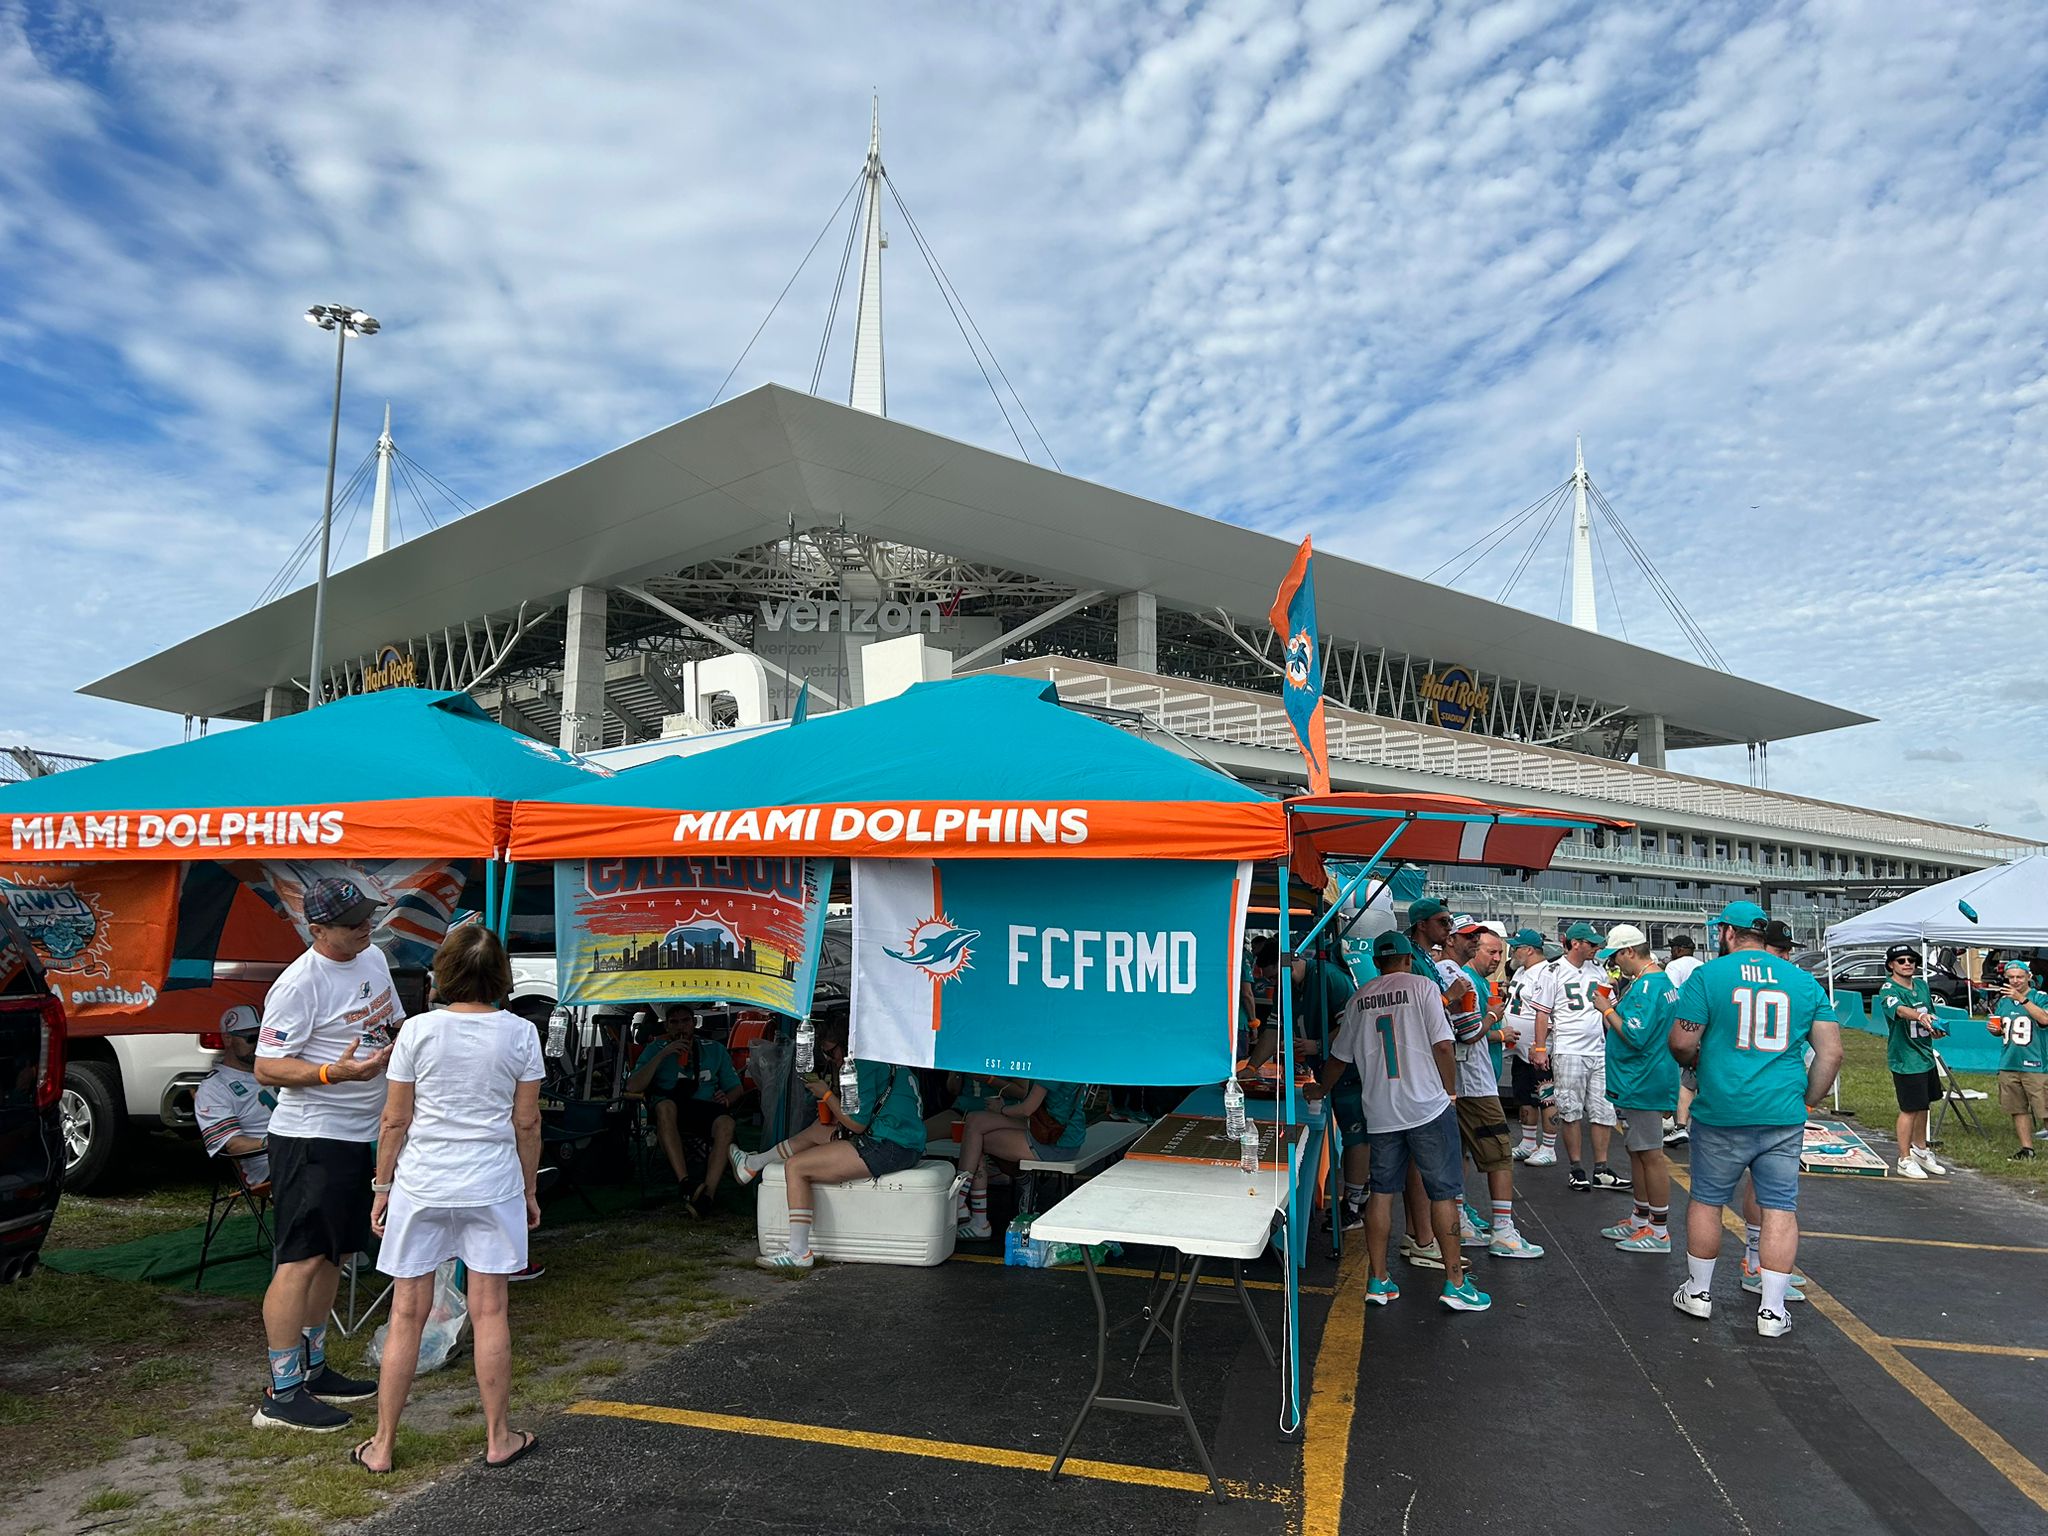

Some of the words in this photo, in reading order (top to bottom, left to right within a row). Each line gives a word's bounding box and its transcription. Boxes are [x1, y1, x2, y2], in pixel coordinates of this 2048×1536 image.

[759, 599, 941, 633] verizon
[759, 641, 818, 655] verizon
[364, 661, 388, 693] Hard
[389, 654, 416, 685] Rock
[801, 663, 849, 678] verizo
[1420, 673, 1459, 703] Hard
[1455, 681, 1489, 715] Rock
[1440, 711, 1466, 724] STADIUM
[11, 815, 128, 850] MIAMI
[137, 810, 345, 848] DOLPHINS
[673, 808, 820, 842] MIAMI
[830, 807, 1089, 845] DOLPHINS
[1006, 924, 1198, 995] FCFRMD
[1740, 964, 1779, 985] HILL
[1732, 987, 1791, 1053] 10
[985, 1058, 1005, 1070] EST.
[1010, 1060, 1032, 1071] 2017
[1375, 1013, 1401, 1080] 1
